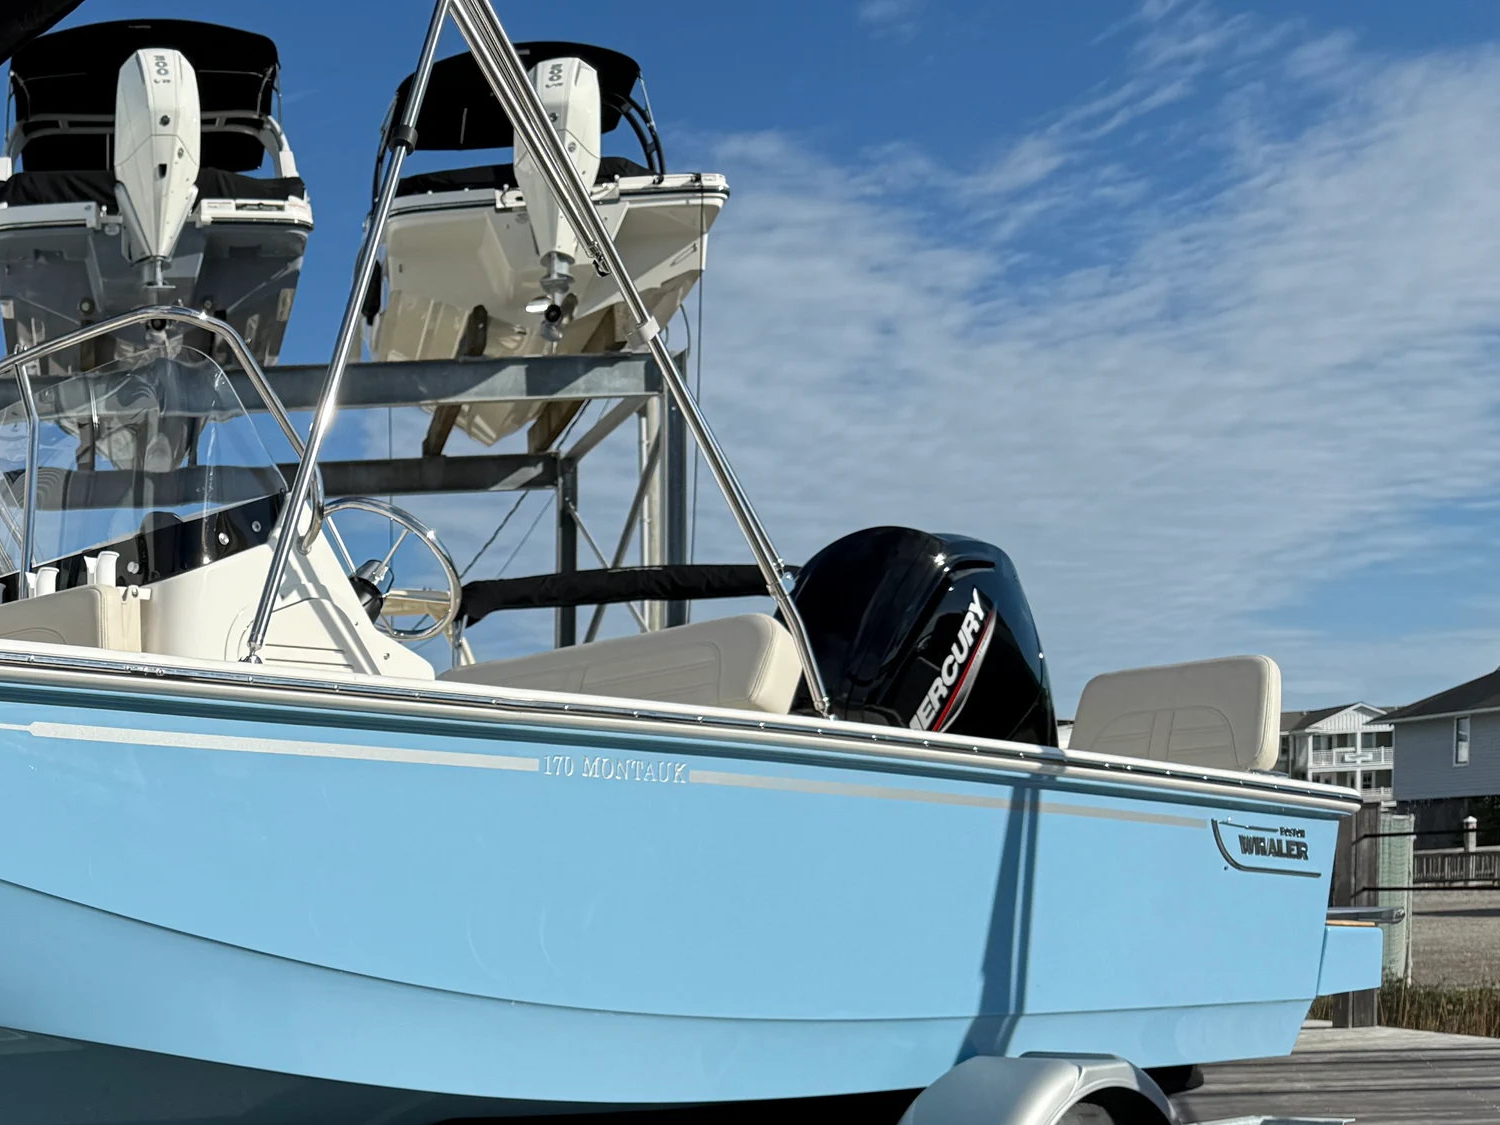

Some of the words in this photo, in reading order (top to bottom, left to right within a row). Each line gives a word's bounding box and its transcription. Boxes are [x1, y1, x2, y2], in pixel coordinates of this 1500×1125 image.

[543, 755, 575, 777] 170
[582, 756, 688, 784] MONTAUK
[1238, 834, 1309, 860] WHALER
